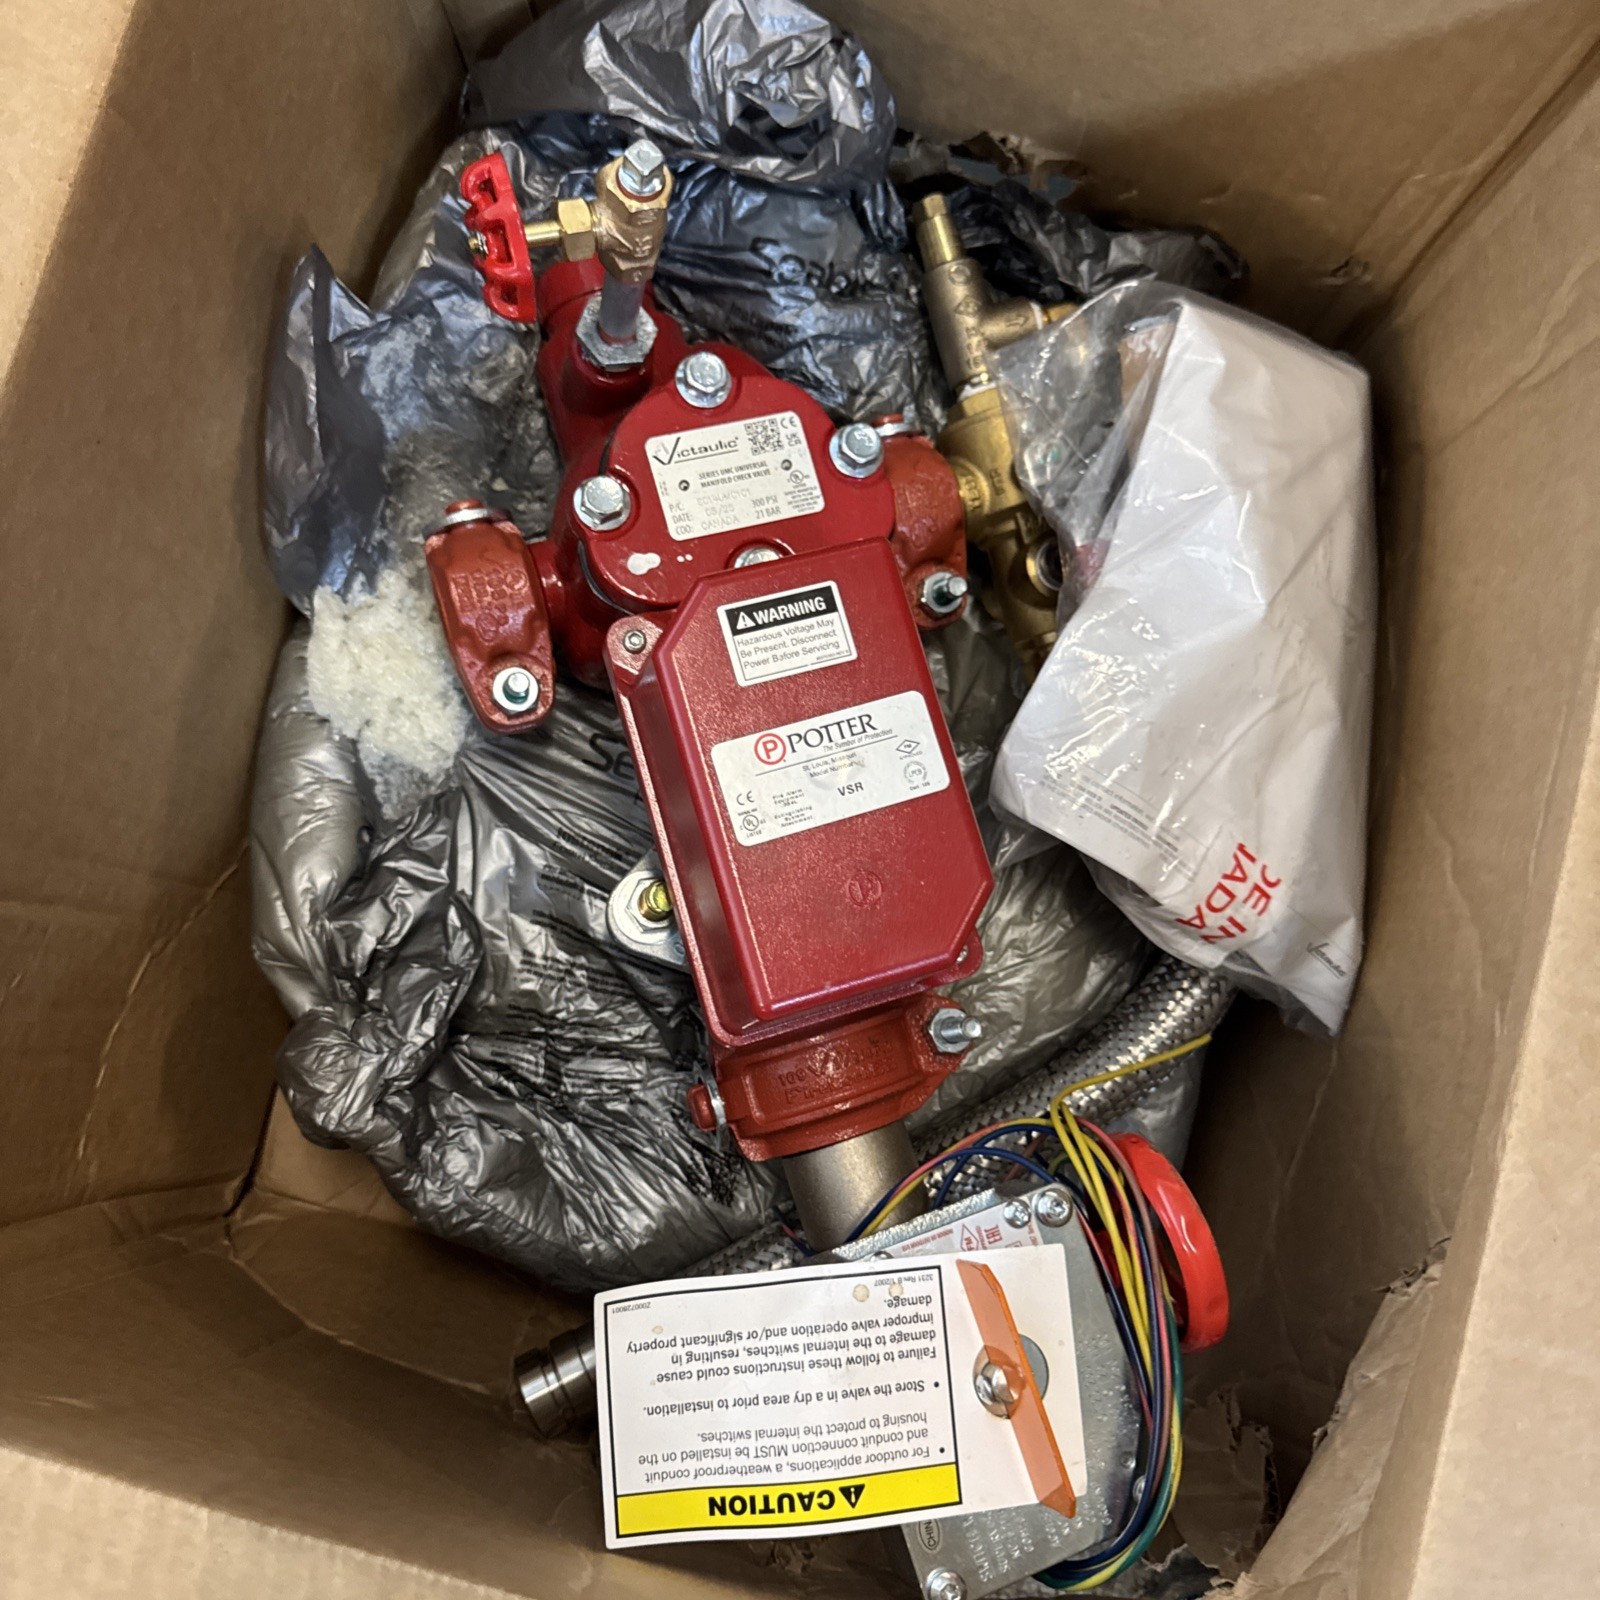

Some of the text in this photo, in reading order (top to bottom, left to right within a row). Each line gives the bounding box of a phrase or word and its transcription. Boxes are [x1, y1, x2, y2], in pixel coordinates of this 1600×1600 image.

[652, 436, 738, 466] Victaulic
[698, 470, 720, 480] SERIES
[734, 460, 768, 473] UNIVERSAL
[700, 468, 771, 488] MANIFOLD CHECK VALVE
[751, 497, 766, 508] 300
[764, 494, 779, 505] PSI
[754, 509, 765, 520] 21
[765, 505, 782, 517] BAR
[671, 512, 693, 525] DATE:
[753, 596, 826, 624] WARNING
[736, 619, 834, 647] Hazardous Voltage May
[739, 629, 837, 659] Be Present. Disconnect
[743, 657, 770, 670] Power
[801, 641, 840, 656] Servicing
[787, 714, 877, 753] POTTER
[834, 739, 856, 750] Symbol
[856, 735, 863, 744] of
[864, 728, 893, 741] Protection
[837, 781, 864, 797] VSR
[918, 1273, 934, 1282] 3231
[884, 1294, 932, 1309] damage.
[626, 1312, 934, 1354] improper valve operation and/or significant property
[670, 1329, 936, 1367] damage to the internal switches, resulting in
[656, 1346, 937, 1383] Failure to follow these instructions could cause
[643, 1379, 925, 1417] Store the valve in a dry area prior to installation.
[697, 1412, 928, 1443] housing to protect the internal switches.
[638, 1428, 929, 1466] and conduit connection MUST be installed on the
[644, 1446, 930, 1484] For outdoor applications, a weatherproof conduit
[708, 1490, 835, 1516] CAUTION
